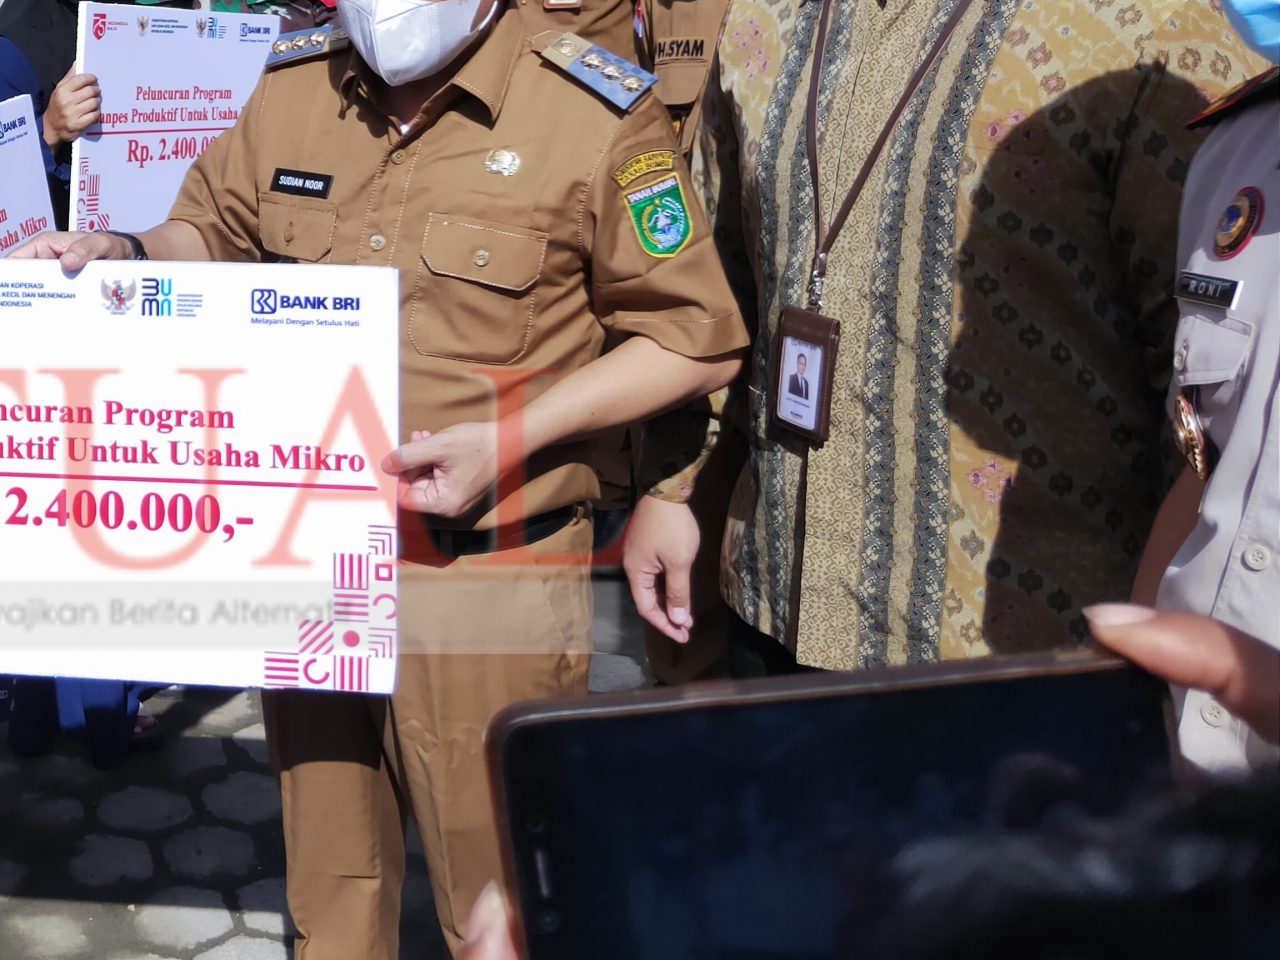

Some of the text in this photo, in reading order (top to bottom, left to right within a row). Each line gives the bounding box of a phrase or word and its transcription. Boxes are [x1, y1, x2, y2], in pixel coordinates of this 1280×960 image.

[247, 26, 262, 35] BANK
[136, 85, 232, 103] Peluncuran Program
[2, 119, 18, 132] BANK
[95, 106, 238, 128] anpes Produktif Untuk Usaha
[127, 140, 154, 168] Rp.
[278, 175, 324, 191] SUDIAN NOOR
[20, 216, 47, 240] Mikro
[1187, 280, 1222, 297] RONI
[280, 295, 360, 310] BANK BRI
[251, 317, 360, 327] Melayani Dengan Setulus Hati
[103, 399, 236, 433] Program
[66, 436, 160, 465] Untuk
[169, 441, 261, 469] Usaha
[269, 444, 366, 474] Mikro
[3, 486, 255, 542] 2.400.000,-
